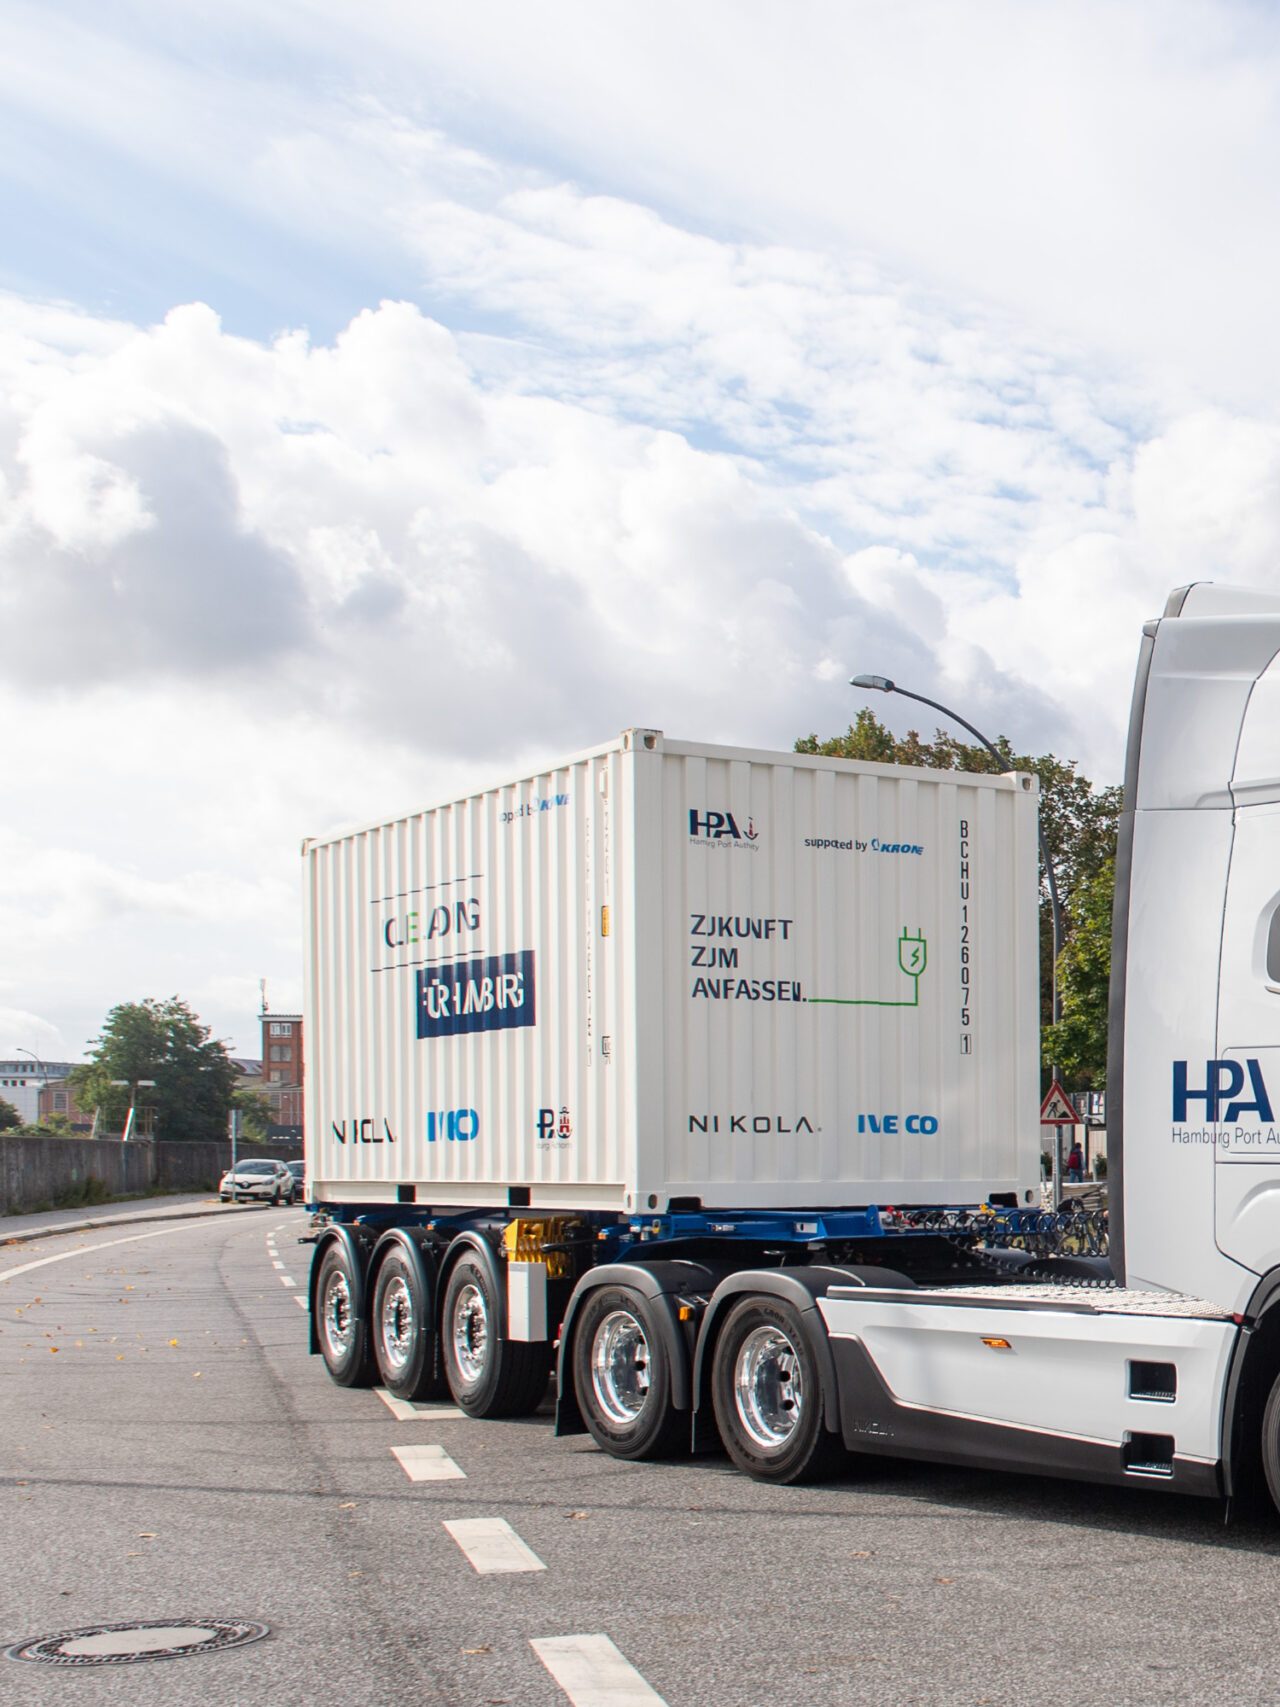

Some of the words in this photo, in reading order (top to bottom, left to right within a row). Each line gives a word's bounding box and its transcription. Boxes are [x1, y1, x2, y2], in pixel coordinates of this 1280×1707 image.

[689, 809, 741, 839] HPA
[855, 840, 867, 852] by
[1172, 1058, 1275, 1123] HPA
[689, 1115, 814, 1134] NIKOLA
[857, 1114, 939, 1136] IVECO
[1171, 1127, 1230, 1149] Hamburg
[1234, 1127, 1262, 1145] Port
